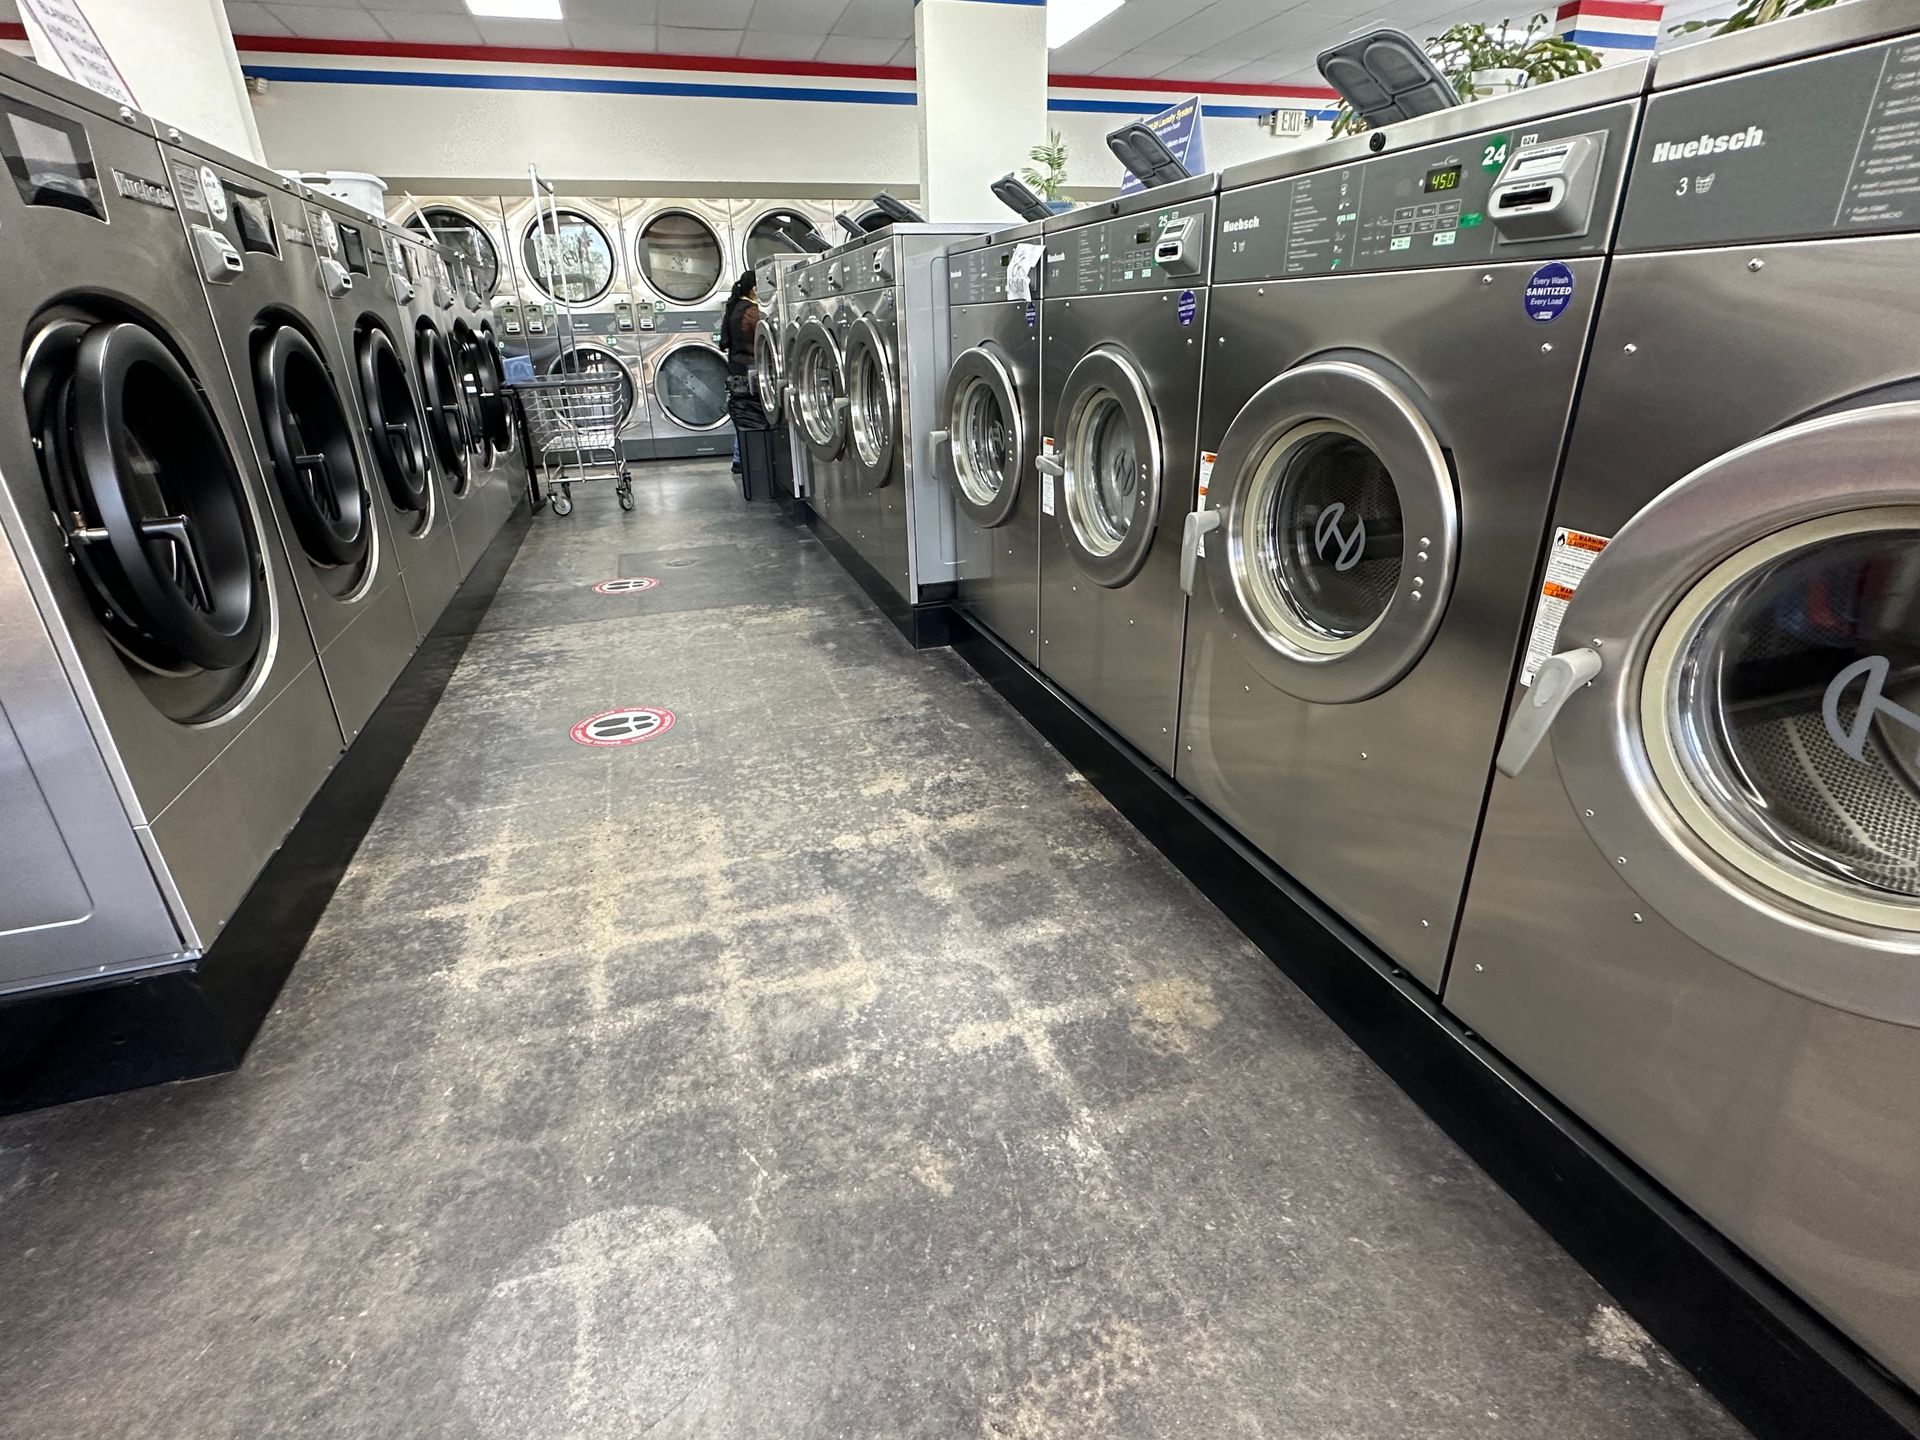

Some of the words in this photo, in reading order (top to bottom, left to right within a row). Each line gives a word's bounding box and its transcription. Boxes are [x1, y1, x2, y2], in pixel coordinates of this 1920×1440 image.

[1281, 111, 1302, 131] EXIT
[1652, 126, 1763, 163] Huebsch
[1482, 144, 1506, 166] 24
[1432, 171, 1456, 189] 450
[1676, 177, 1688, 196] 3
[1158, 215, 1168, 227] 25
[1223, 216, 1260, 233] Huebsch
[1533, 277, 1550, 286] Every
[1551, 277, 1569, 285] Wash
[1526, 286, 1572, 296] SANITIZED
[1530, 297, 1547, 307] Every
[1547, 297, 1564, 305] Load
